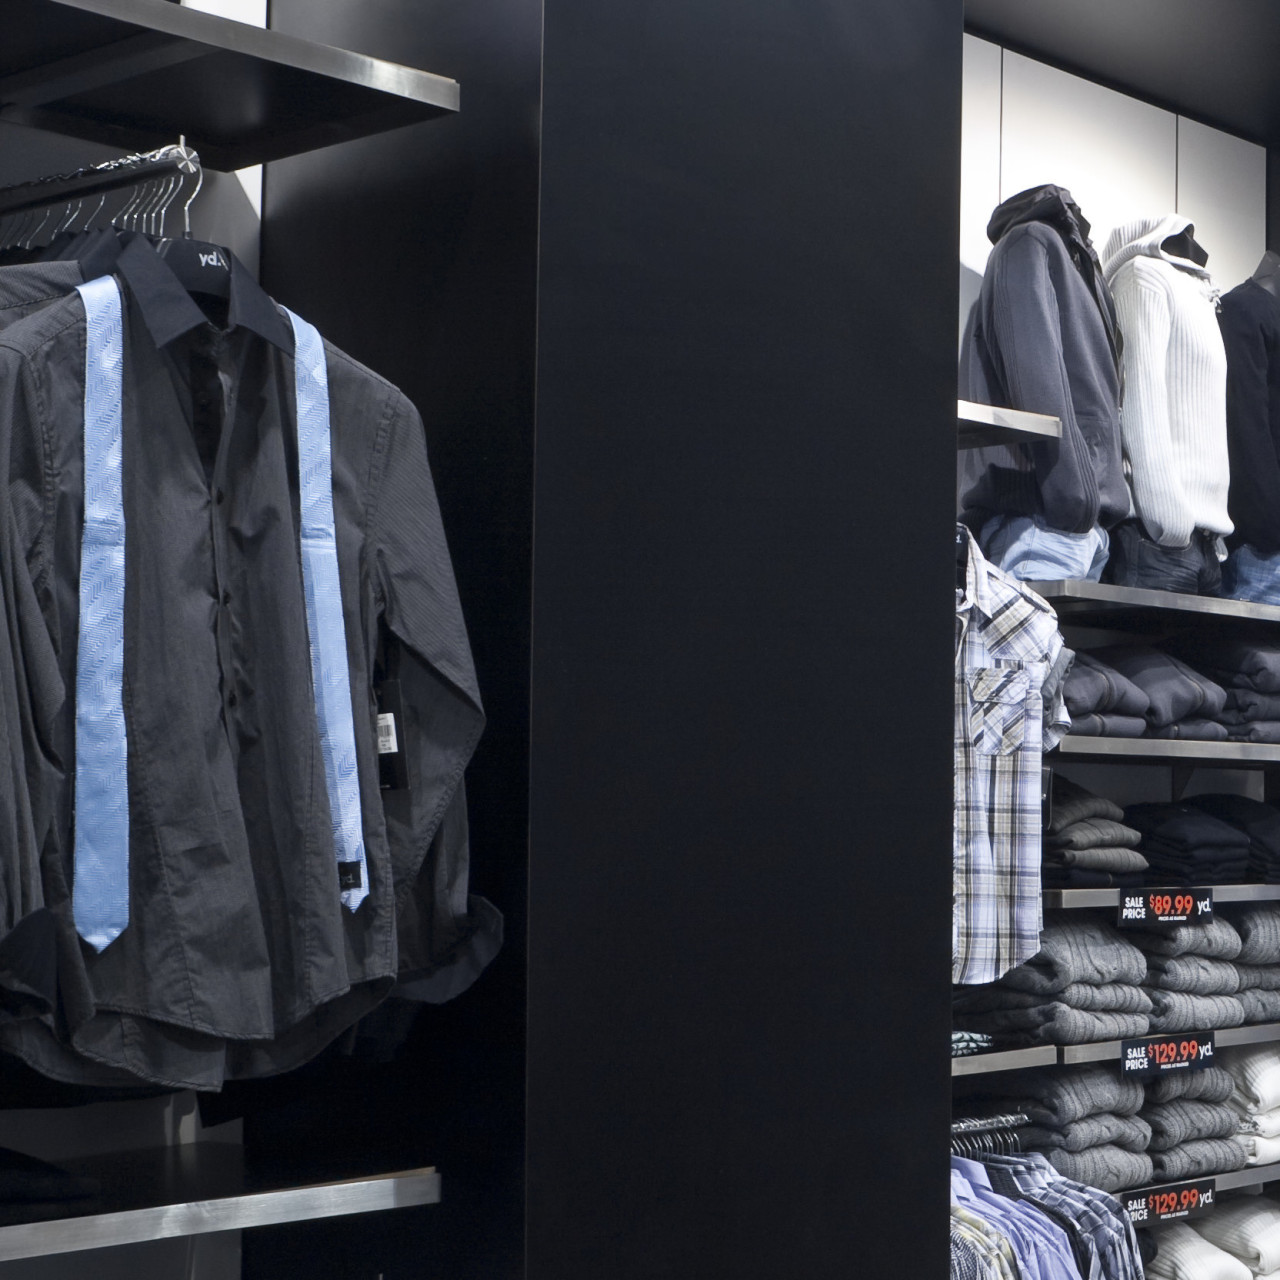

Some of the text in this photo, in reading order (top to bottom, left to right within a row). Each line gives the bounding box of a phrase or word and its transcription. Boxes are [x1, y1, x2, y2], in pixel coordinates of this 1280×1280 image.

[199, 251, 221, 267] yd.
[1125, 897, 1143, 908] SALE
[1149, 893, 1211, 915] $89.99 yd.
[1122, 908, 1146, 919] PRICE
[1127, 1047, 1146, 1059] SALE
[1148, 1040, 1213, 1063] $129.99 yd.
[1125, 1058, 1148, 1071] PRICE
[1127, 1198, 1146, 1211] SALE
[1148, 1188, 1213, 1215] $129.99 yd.
[1130, 1209, 1148, 1222] RICE
